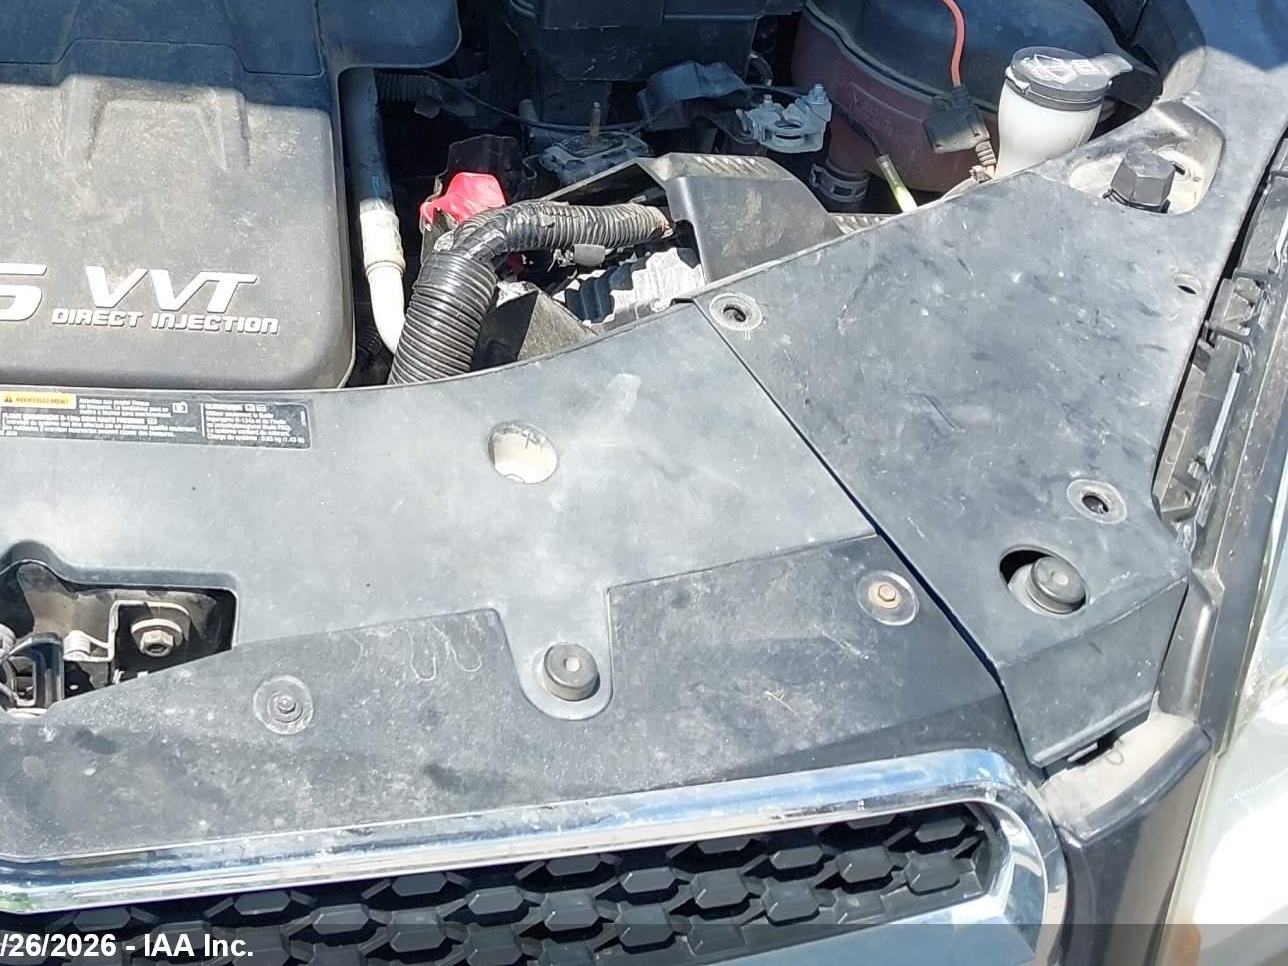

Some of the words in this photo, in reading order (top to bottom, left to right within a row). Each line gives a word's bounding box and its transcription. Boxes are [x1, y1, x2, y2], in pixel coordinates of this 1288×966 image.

[85, 265, 259, 314] VVT
[50, 307, 144, 329] DIRECT
[150, 312, 280, 336] INJECTION
